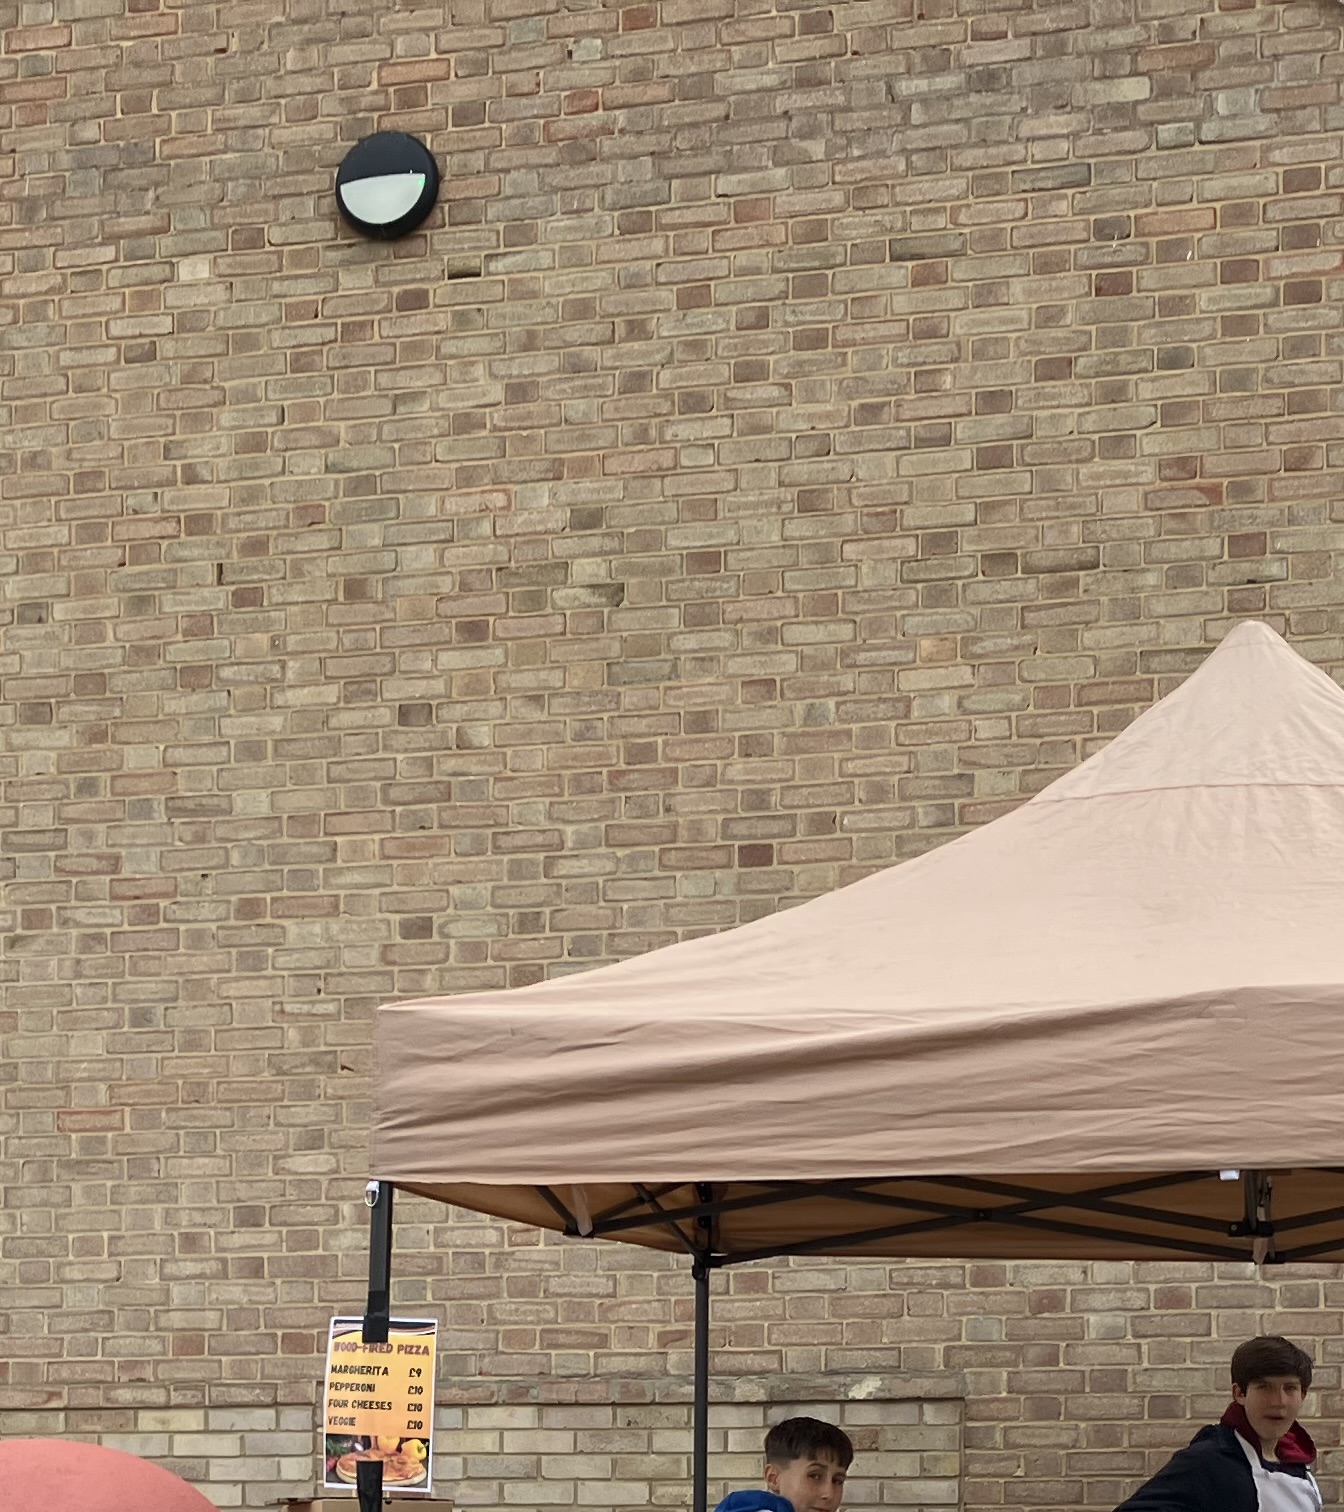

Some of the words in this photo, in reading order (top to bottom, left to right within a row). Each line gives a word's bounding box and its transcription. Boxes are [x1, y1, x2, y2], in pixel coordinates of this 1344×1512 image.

[397, 1344, 430, 1356] PIZZA
[330, 1364, 389, 1376] MARGHERITA
[408, 1368, 422, 1378] £9
[329, 1382, 376, 1392] PEPPERONI
[407, 1386, 423, 1395] £10
[328, 1399, 349, 1408] FOUR
[351, 1400, 393, 1411] CHEESES
[407, 1403, 423, 1412] £10
[328, 1416, 357, 1426] VEGGIE
[406, 1420, 423, 1430] £10
